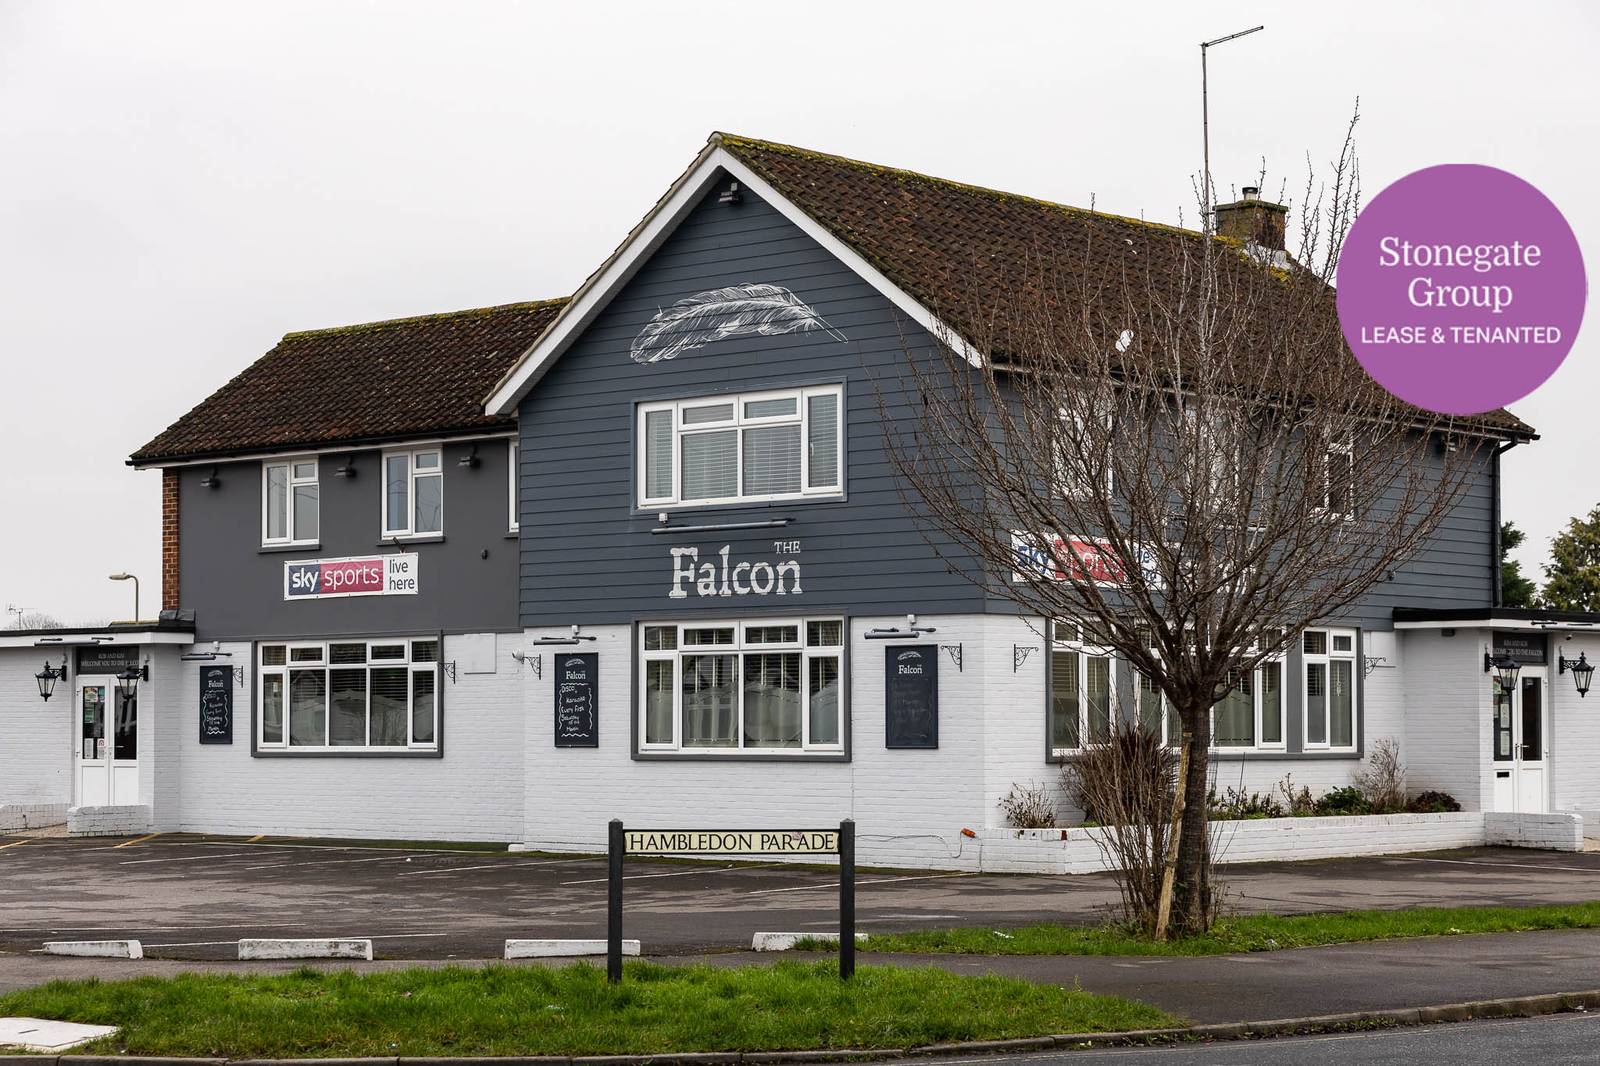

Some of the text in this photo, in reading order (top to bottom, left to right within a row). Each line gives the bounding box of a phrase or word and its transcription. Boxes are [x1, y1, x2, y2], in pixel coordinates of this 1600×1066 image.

[774, 541, 801, 554] THE
[389, 559, 409, 574] live
[668, 545, 803, 599] Falcon
[292, 565, 380, 592] sky sports
[389, 577, 415, 590] here
[566, 671, 586, 680] Falcon
[898, 665, 922, 674] Falcon
[630, 833, 834, 851] HAMBLEDON PARADE
